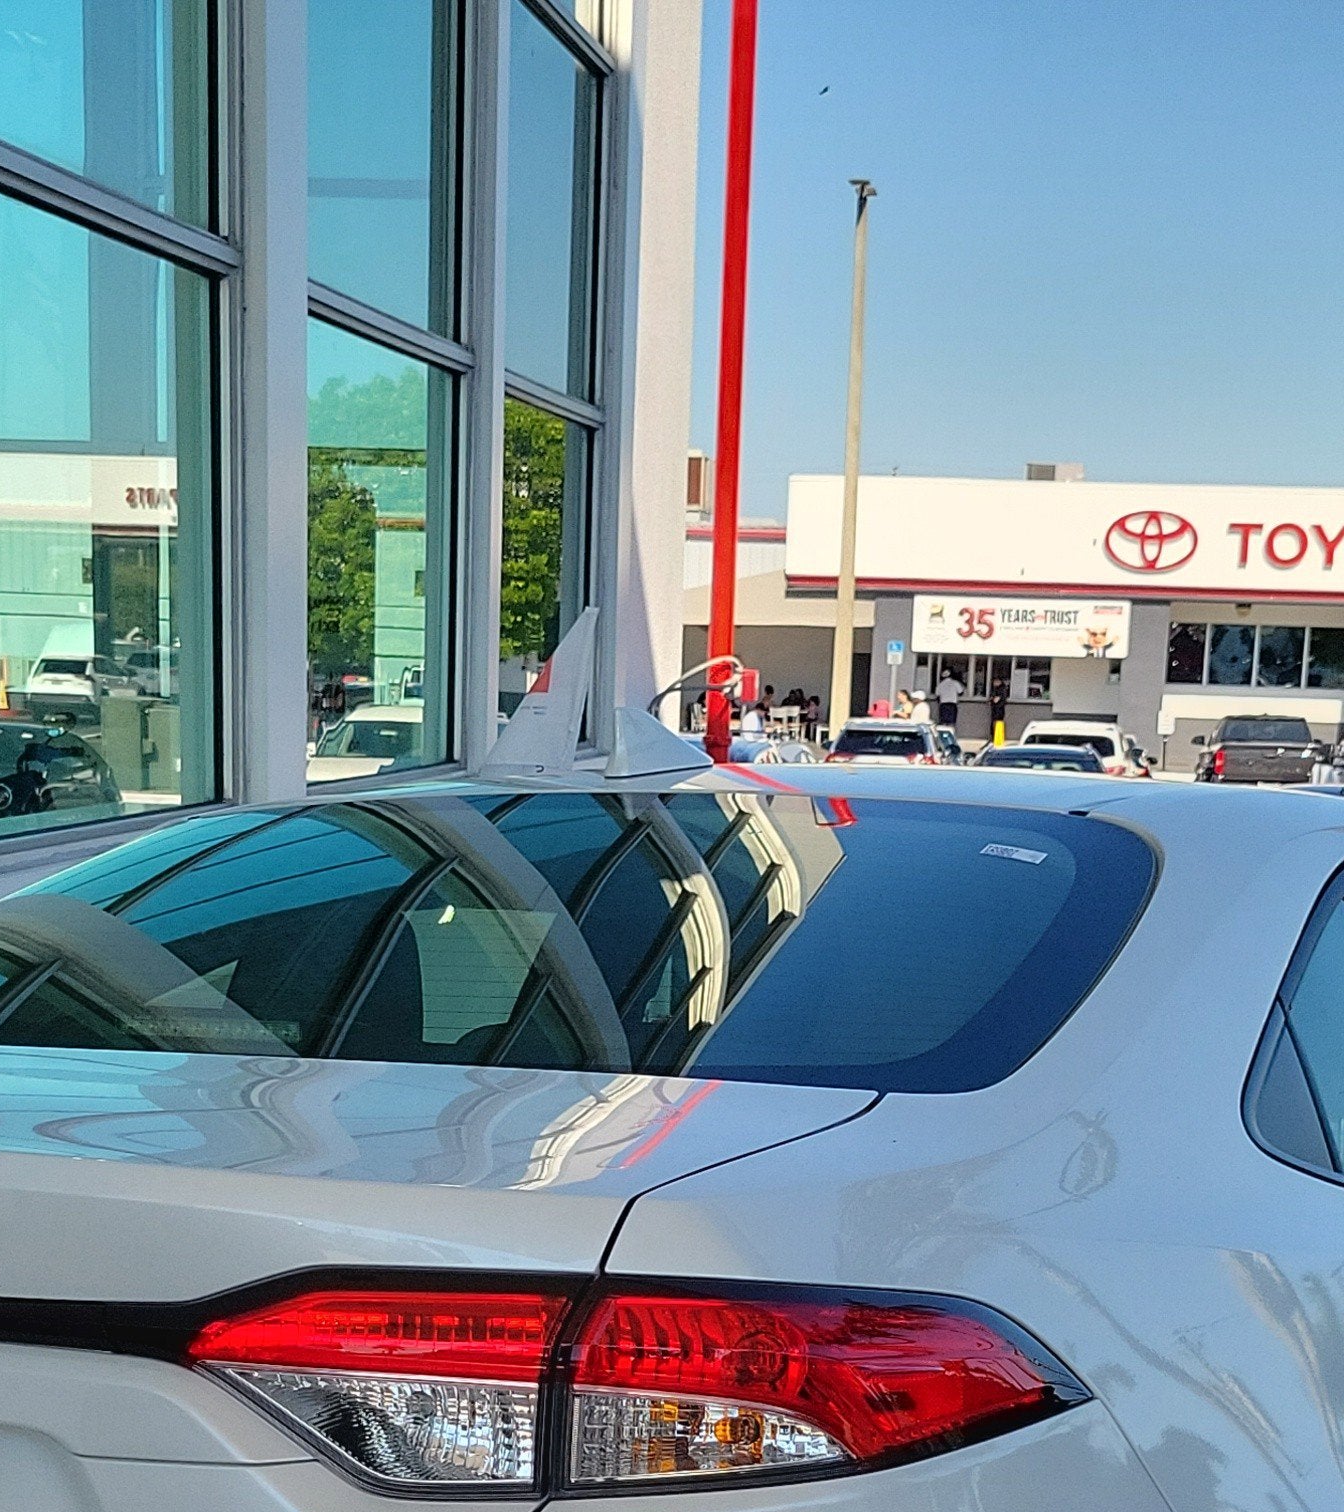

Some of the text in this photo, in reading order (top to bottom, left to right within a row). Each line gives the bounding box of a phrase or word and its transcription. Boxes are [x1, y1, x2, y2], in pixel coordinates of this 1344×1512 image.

[957, 606, 996, 640] 35
[1000, 608, 1036, 624] YEARS
[1043, 609, 1080, 625] TRUST
